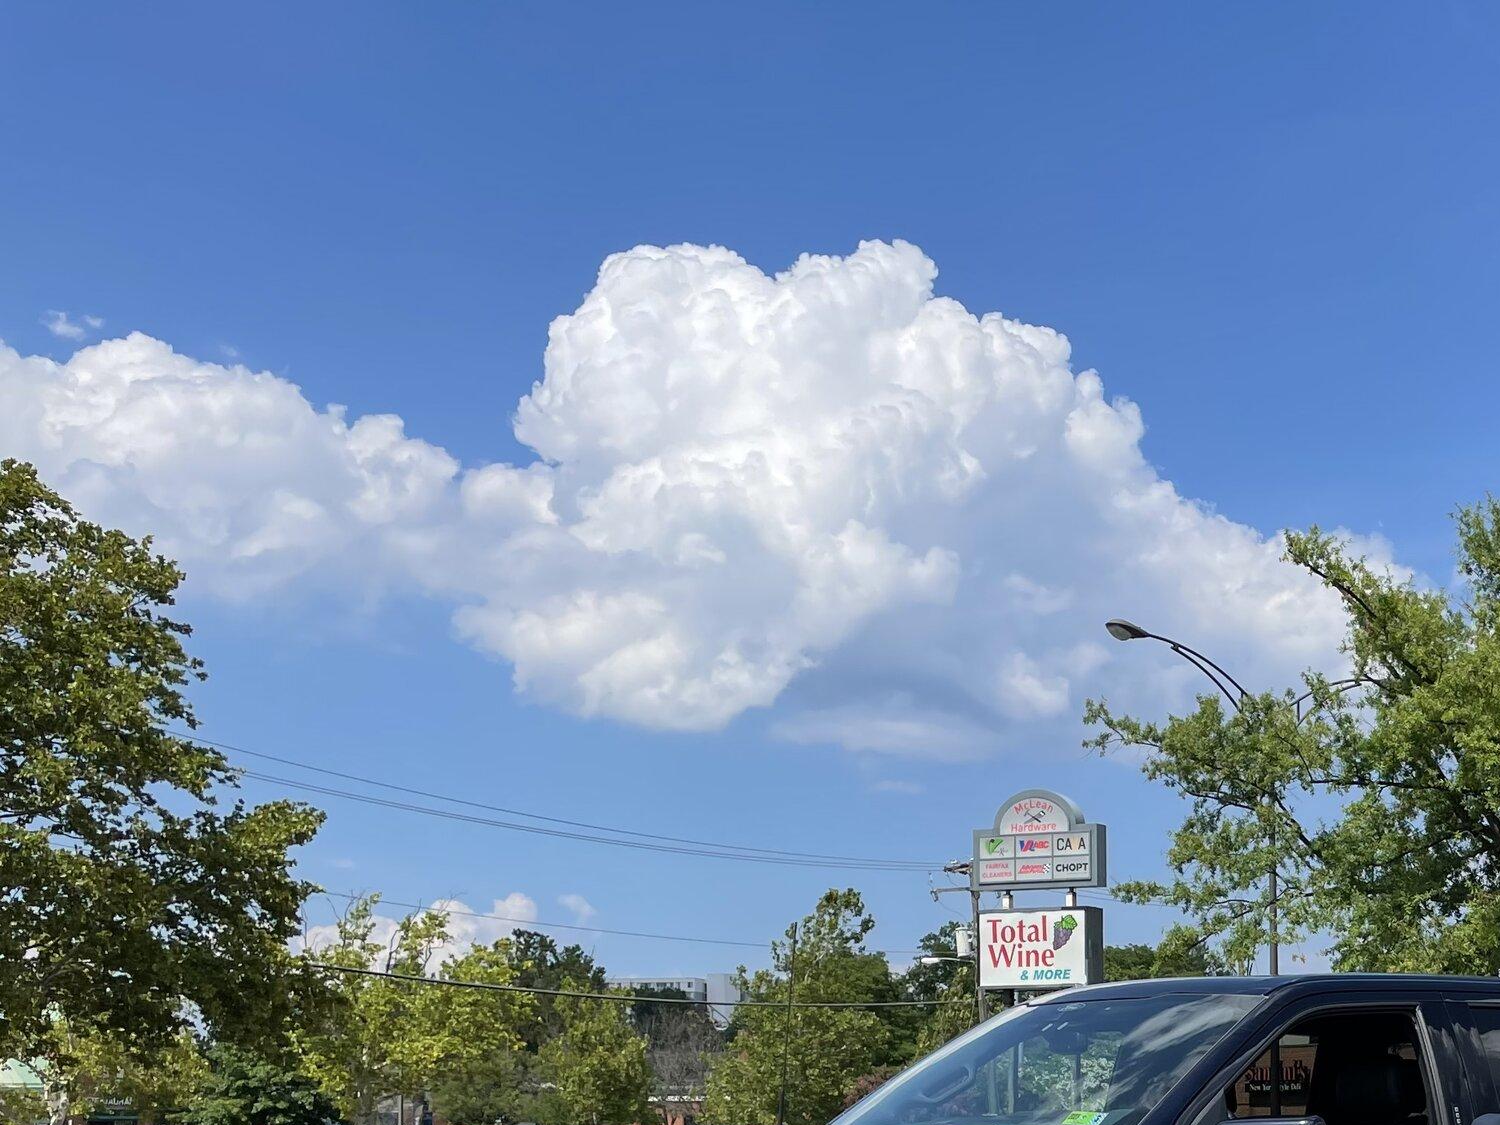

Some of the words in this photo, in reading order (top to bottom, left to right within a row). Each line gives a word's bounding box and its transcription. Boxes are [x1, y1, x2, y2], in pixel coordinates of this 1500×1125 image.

[1013, 800, 1054, 815] McLean
[1011, 822, 1057, 832] Hardware
[1056, 863, 1088, 873] CHOPT
[987, 915, 1048, 943] Total
[988, 943, 1055, 968] Wine
[1020, 970, 1029, 980] &
[1033, 969, 1071, 980] MORE
